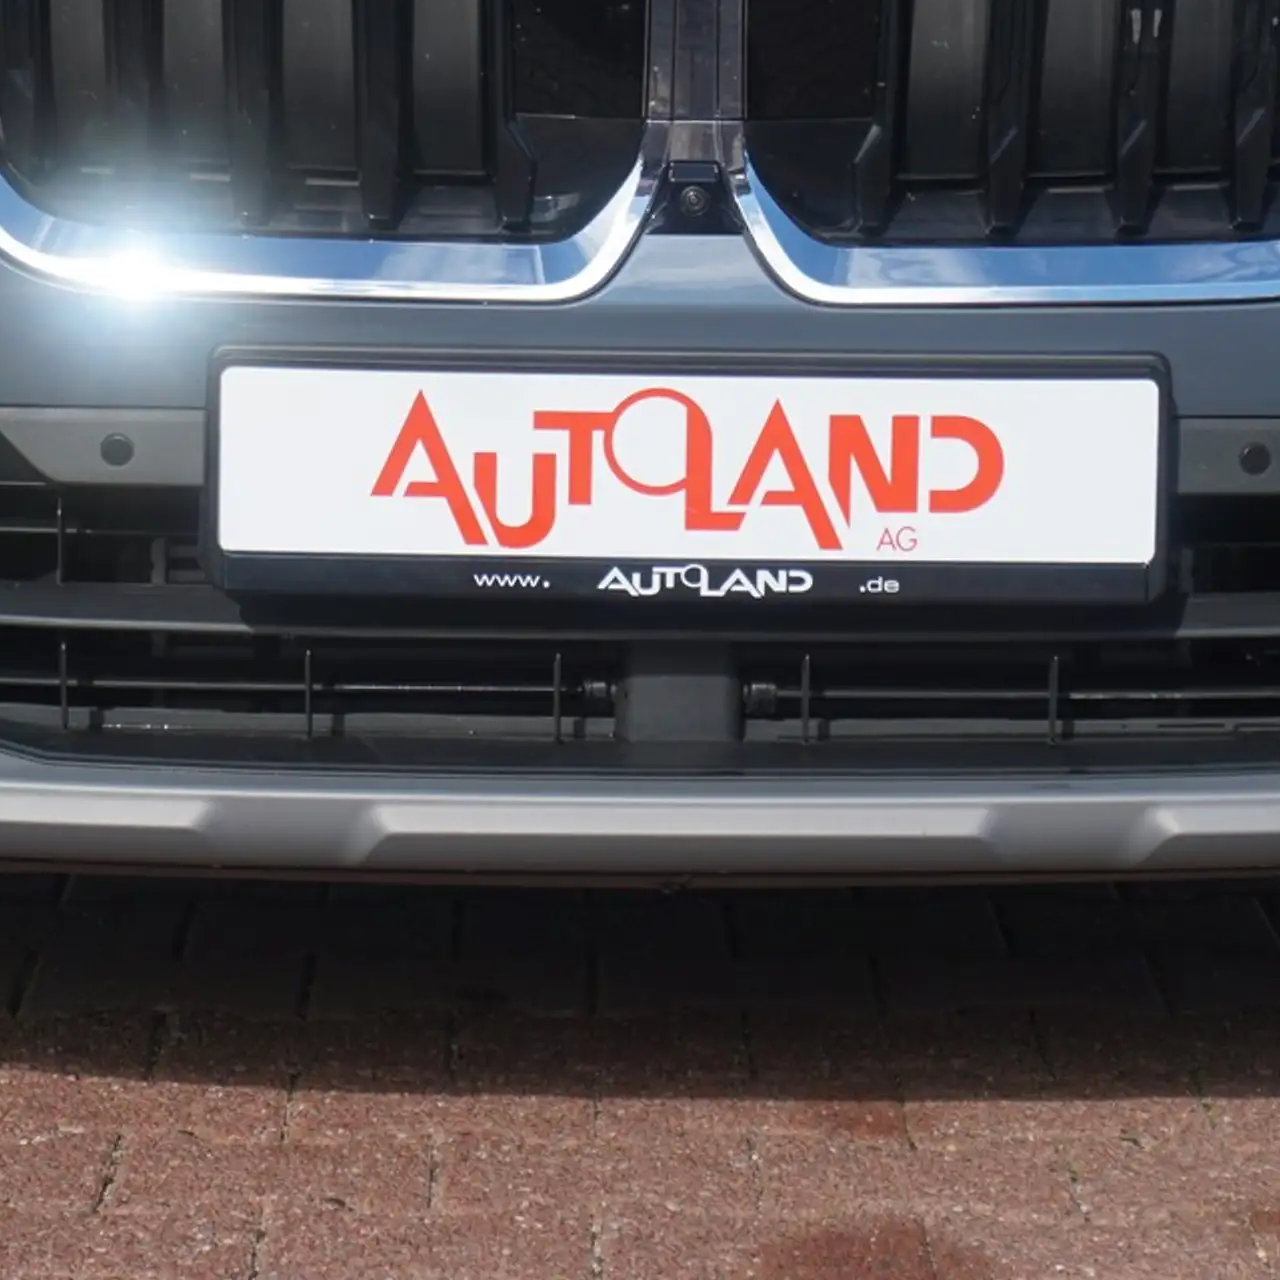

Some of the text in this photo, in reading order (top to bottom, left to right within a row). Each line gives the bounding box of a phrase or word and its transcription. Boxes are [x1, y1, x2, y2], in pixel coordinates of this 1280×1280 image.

[370, 387, 1005, 550] AUTOLAND
[875, 526, 918, 552] AG
[472, 563, 900, 599] www. AUTOLAND .de
